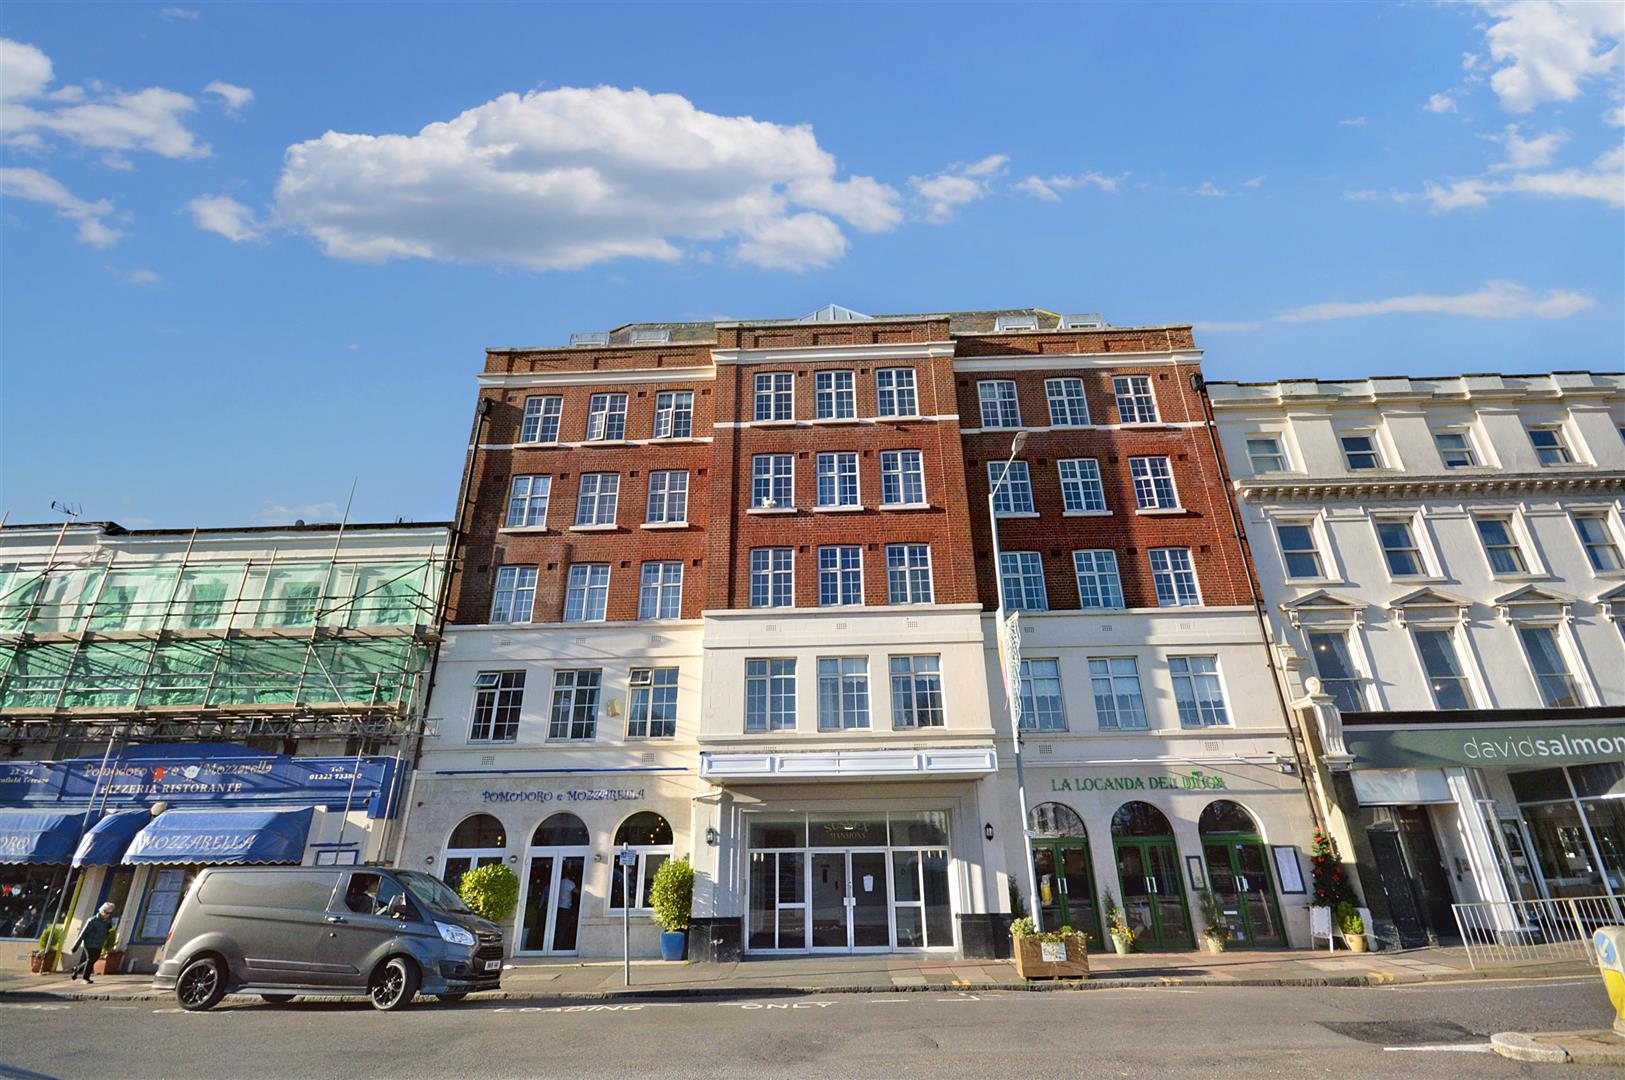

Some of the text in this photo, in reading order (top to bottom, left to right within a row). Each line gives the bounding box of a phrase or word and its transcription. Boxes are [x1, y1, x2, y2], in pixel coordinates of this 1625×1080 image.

[203, 760, 273, 776] Mozzarella
[100, 783, 242, 794] PIZZERIA RISTORANTE
[1052, 779, 1072, 791] LA
[1076, 777, 1145, 791] LOCANDA
[1149, 777, 1178, 790] DEL
[482, 790, 553, 803] POMODORO
[137, 834, 257, 854] MOZZARELLA
[493, 1004, 645, 1013] LOADING
[741, 1002, 839, 1010] ONLY
